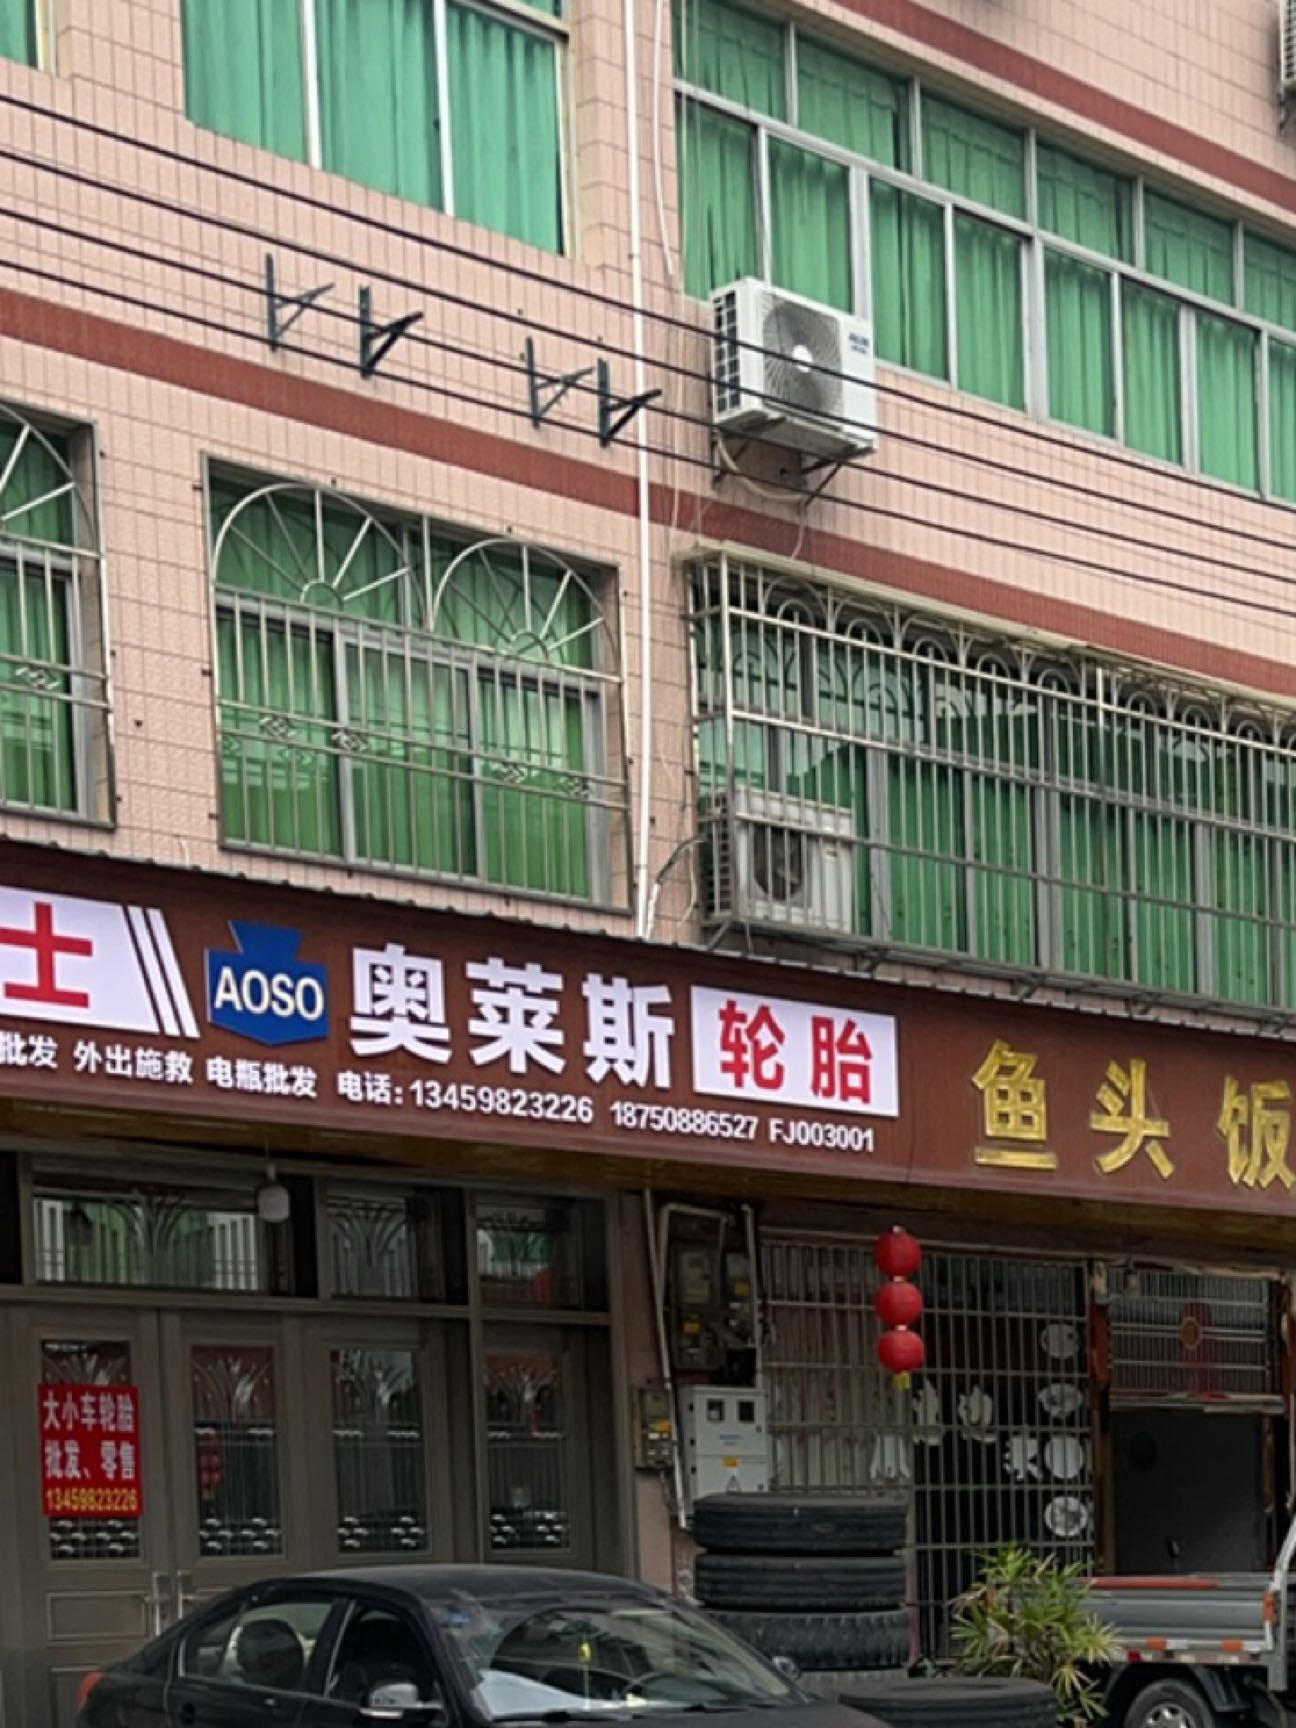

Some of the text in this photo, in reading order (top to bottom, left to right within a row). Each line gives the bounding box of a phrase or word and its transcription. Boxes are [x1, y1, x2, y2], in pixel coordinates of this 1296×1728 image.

[0, 901, 93, 1009] 士
[215, 966, 324, 1021] AOSO
[350, 943, 674, 1088] 奥莱斯
[719, 1000, 873, 1104] 轮胎
[73, 1039, 194, 1085] 外出施救
[206, 1055, 318, 1099] 电瓶批发
[609, 1101, 759, 1141] 18750886527
[769, 1119, 875, 1153] FJ003001
[43, 1390, 135, 1432] 大小车轮胎
[47, 1487, 138, 1512] 13459823226
